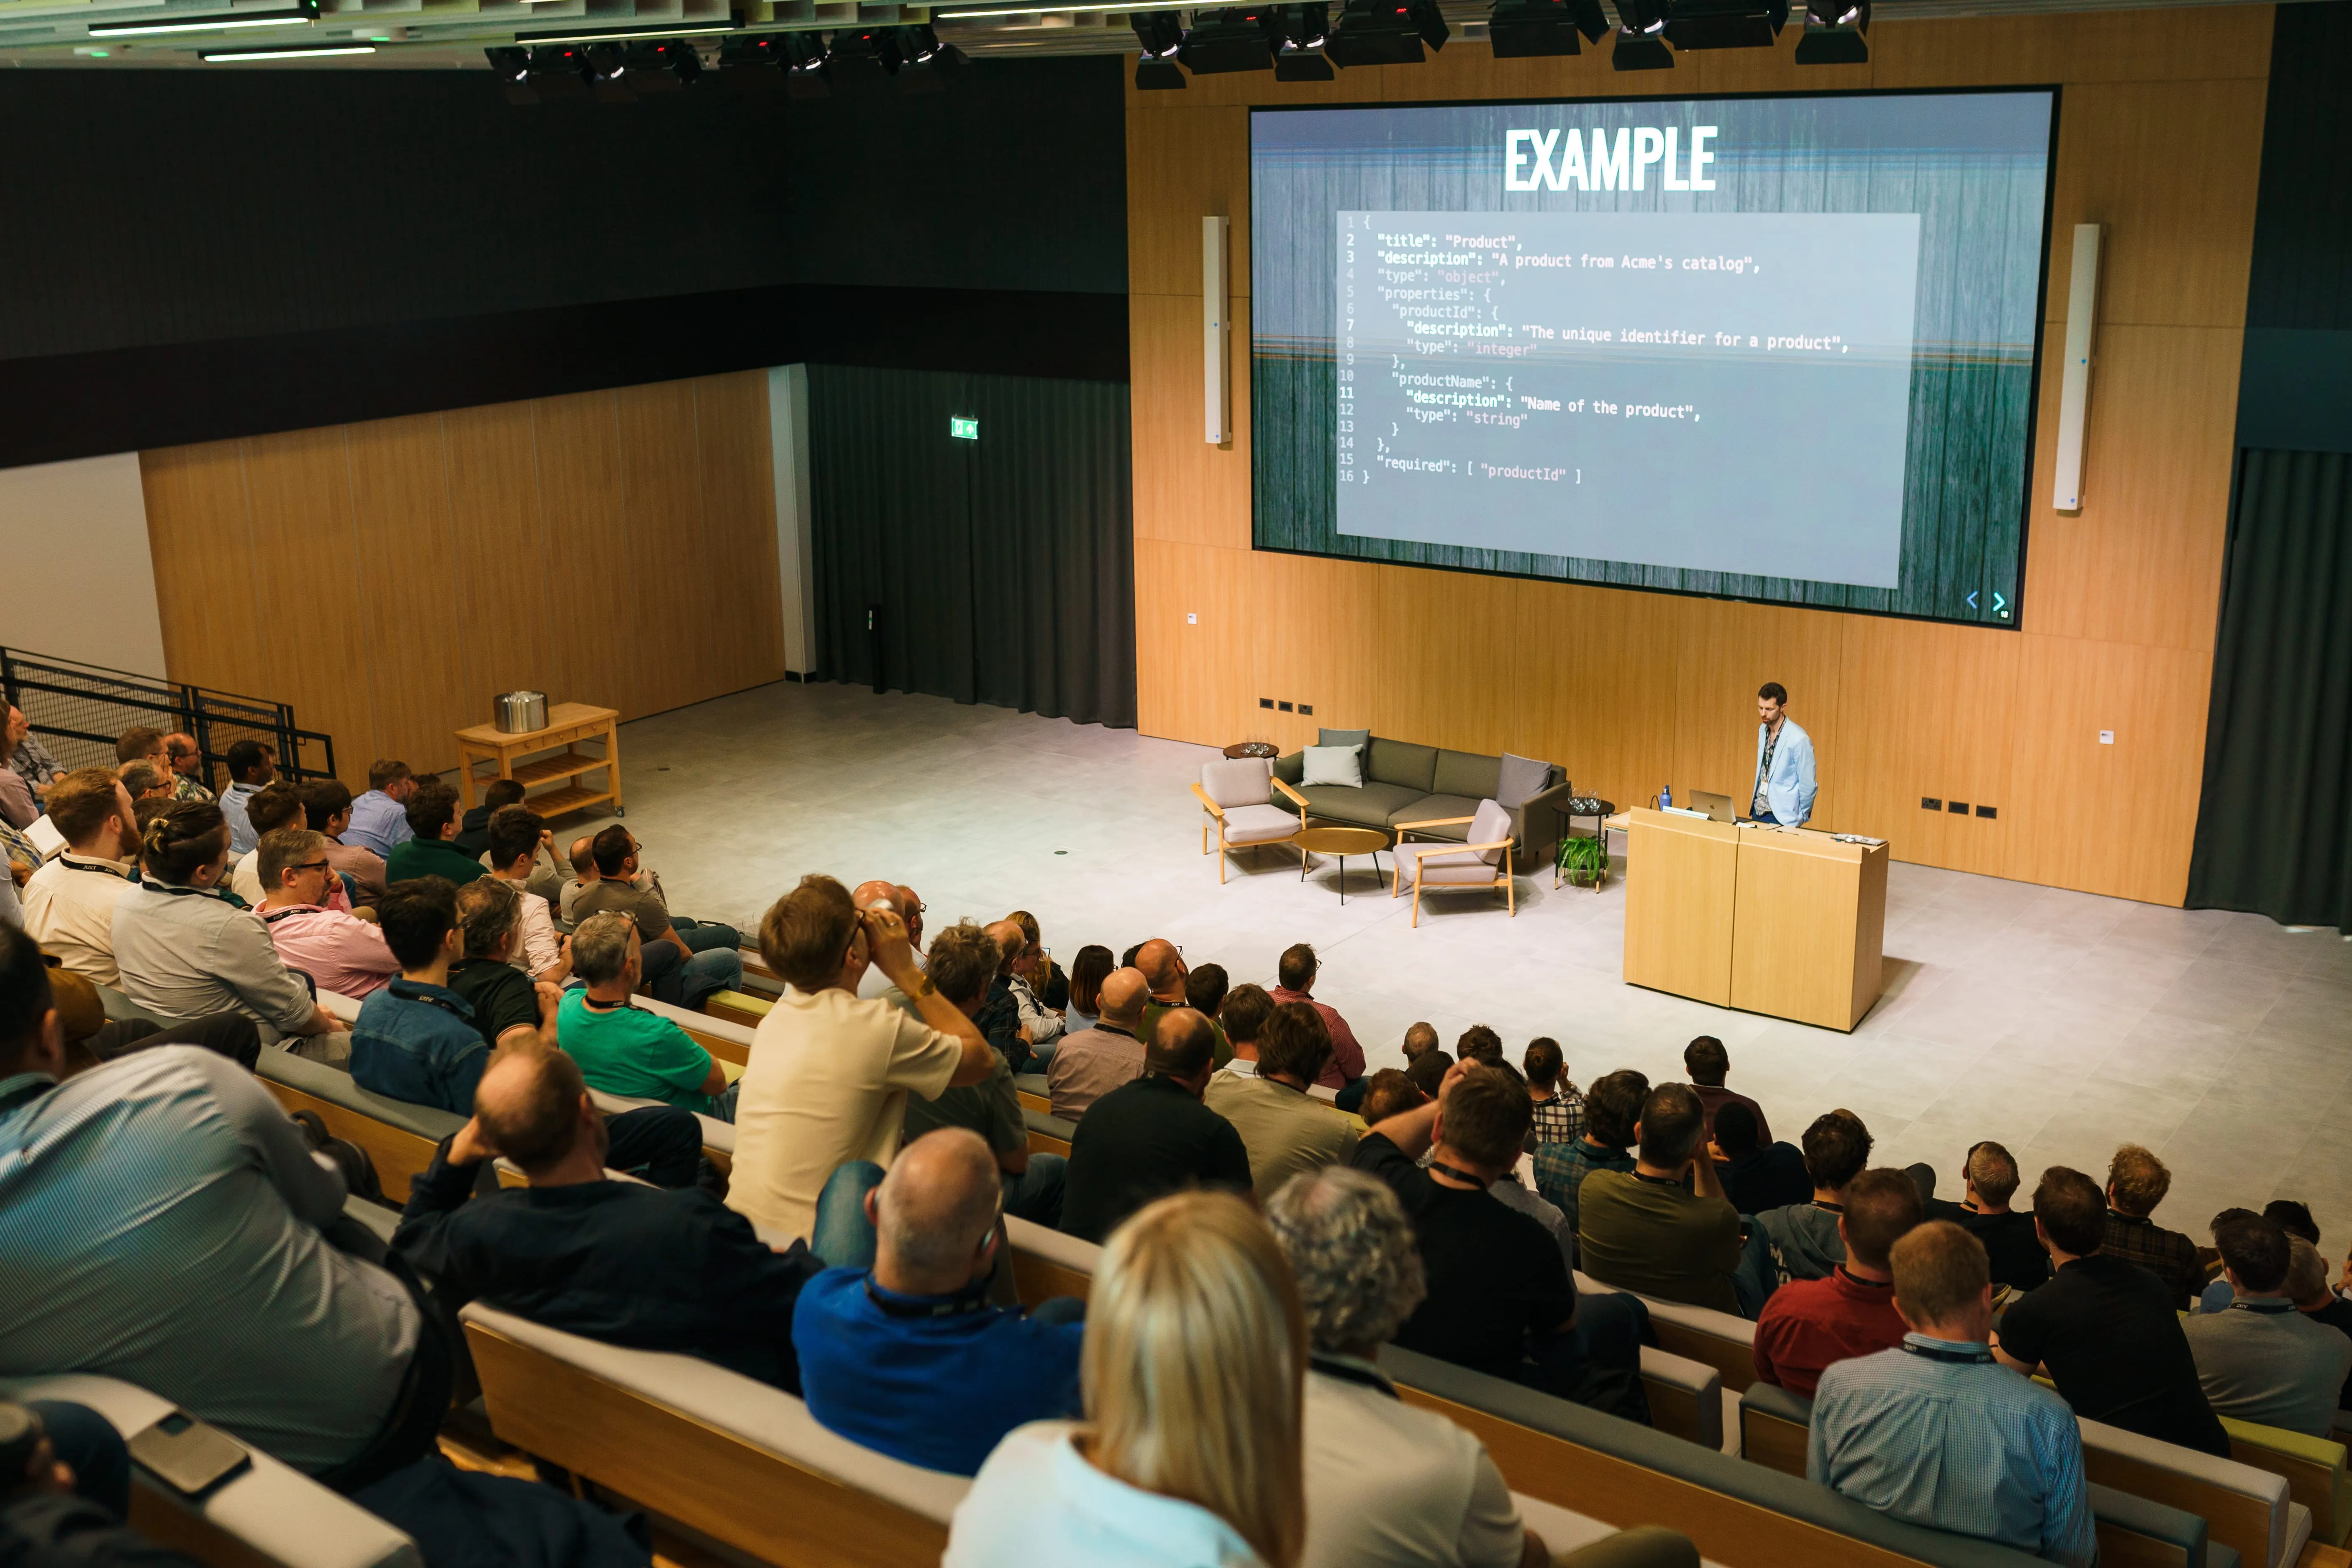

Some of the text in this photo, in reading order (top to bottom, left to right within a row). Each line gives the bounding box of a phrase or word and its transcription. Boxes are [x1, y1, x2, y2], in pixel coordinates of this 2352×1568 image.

[1506, 126, 1718, 191] EXAMPLE
[1347, 215, 1370, 229] 1 {
[1347, 233, 1522, 251] 2 "title": "Product",
[1347, 250, 1760, 274] 3 "description": "A product from Acme's catalog",
[1347, 268, 1505, 286] 4 "type": "object",
[1347, 285, 1490, 302] 5 "properties": {
[1347, 303, 1498, 320] 6 "productId": {
[1347, 319, 1848, 354] 7 "description": "The unique identifier for a product",
[1347, 337, 1536, 358] 8 "type": "integer"
[1347, 354, 1405, 370] 9 },
[1340, 369, 1513, 391] 10 "productName": {
[1340, 387, 1700, 422] 11 "description": "Name of the product",
[1340, 403, 1527, 428] 12 "type": "string"
[1340, 420, 1398, 436] 13 }
[1340, 436, 1389, 453] 14 },
[1340, 453, 1580, 484] 15 "required": [ "productId" ]
[1340, 470, 1369, 484] 16 }
